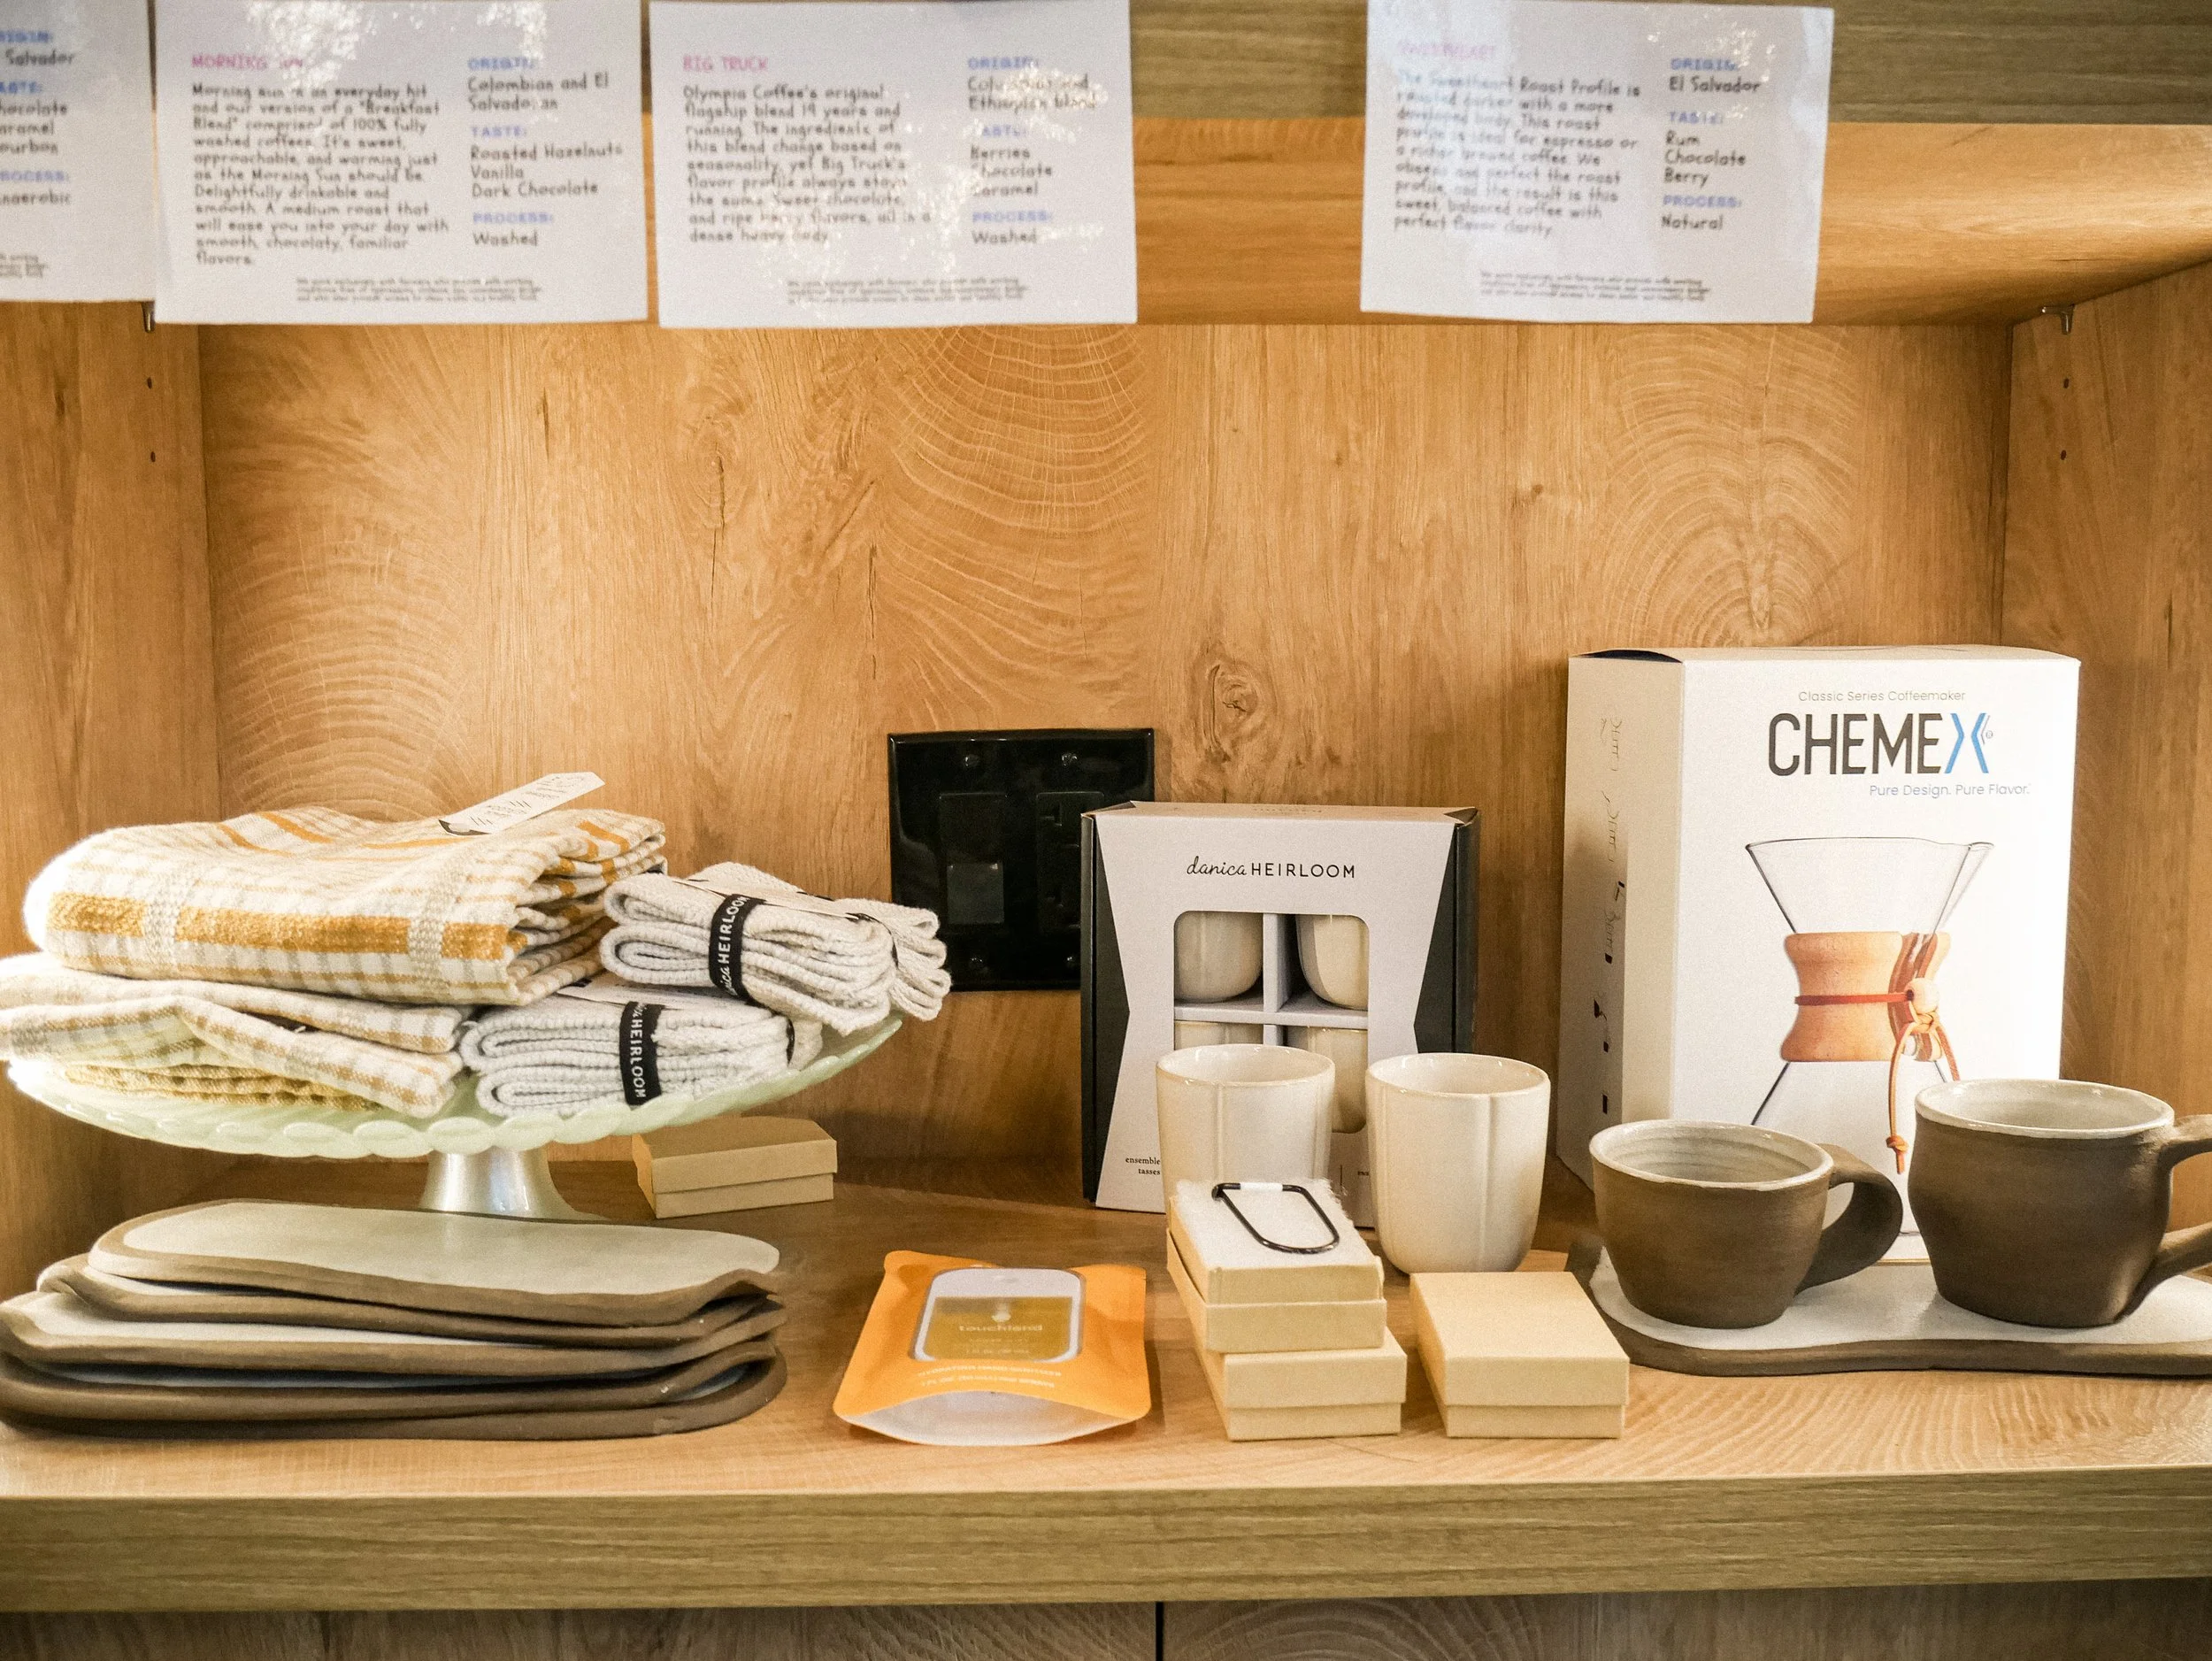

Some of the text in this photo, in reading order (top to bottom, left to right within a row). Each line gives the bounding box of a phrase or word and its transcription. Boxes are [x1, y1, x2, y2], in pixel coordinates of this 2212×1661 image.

[5, 49, 74, 65] Salvador
[683, 55, 769, 73] BIG TRUCK
[468, 72, 610, 93] Colombian and El
[1520, 76, 1640, 97] Roast Profile is
[1669, 75, 1762, 94] El Salvador
[193, 82, 251, 101] Morning
[334, 83, 399, 102] everyday
[407, 83, 426, 96] hit
[683, 83, 884, 104] Olympia Coffee's original
[193, 101, 218, 114] and
[226, 104, 250, 113] our
[260, 104, 314, 114] version
[321, 99, 338, 113] of
[685, 101, 747, 123] flagship
[754, 103, 795, 118] blend
[823, 106, 867, 121] years
[874, 101, 901, 118] and
[1519, 96, 1552, 111] with
[1574, 102, 1613, 112] more
[0, 119, 54, 135] aramel
[330, 116, 346, 130] of
[354, 118, 387, 130] 100%
[394, 117, 426, 135] fully
[1522, 113, 1550, 129] This
[1557, 116, 1600, 130] roast
[753, 119, 895, 142] The ingredients of
[1666, 129, 1700, 146] Rum
[0, 140, 58, 154] ourbon
[194, 135, 250, 148] washed
[687, 136, 902, 158] this blend change based on
[1514, 129, 1536, 146] for
[1544, 136, 1614, 152] espresso
[1620, 138, 1638, 150] or
[470, 140, 623, 161] Roasted Hazelnuts
[970, 144, 1031, 160] Berries
[1578, 152, 1601, 166] We
[1664, 149, 1747, 166] Chocolate
[307, 151, 332, 165] and
[408, 152, 437, 170] just
[790, 156, 906, 176] yet Big Truck's
[220, 167, 244, 181] the
[252, 168, 310, 184] Morning
[316, 166, 341, 181] Sun
[349, 167, 399, 183] should
[470, 165, 525, 180] Vanilla
[1548, 168, 1621, 185] the roast
[1663, 166, 1709, 188] Berry
[472, 177, 599, 199] Dark Chocolate
[687, 173, 733, 188] flavor
[743, 173, 795, 194] profile
[803, 175, 856, 191] always
[0, 188, 71, 205] naerobic
[195, 184, 389, 202] Delightfully drinkable and
[689, 192, 714, 206] the
[1569, 189, 1581, 202] is
[1589, 187, 1619, 203] this
[1663, 195, 1742, 208] PROCESS:
[266, 201, 429, 216] A medium roast that
[1517, 202, 1563, 216] coffee
[1571, 204, 1602, 219] with
[689, 210, 715, 226] and
[1394, 212, 1446, 232] perfect
[1662, 213, 1724, 231] Natural
[196, 218, 449, 238] will ease you into your day with
[690, 228, 733, 242] dense
[972, 228, 1038, 245] Washed
[349, 235, 408, 250] familiar
[472, 228, 539, 247] Washed
[1798, 690, 1966, 702] Classic Series Coffeemaker
[1870, 784, 1899, 796] Pure
[1903, 784, 1951, 799] Design.
[1955, 784, 1985, 796] Pure
[1187, 856, 1356, 879] danica HEIRLOOM
[717, 896, 751, 965] HEIRLOOM
[630, 1019, 647, 1098] HEIRLOOM
[1125, 1156, 1161, 1165] ensemble
[1138, 1167, 1161, 1176] tasses
